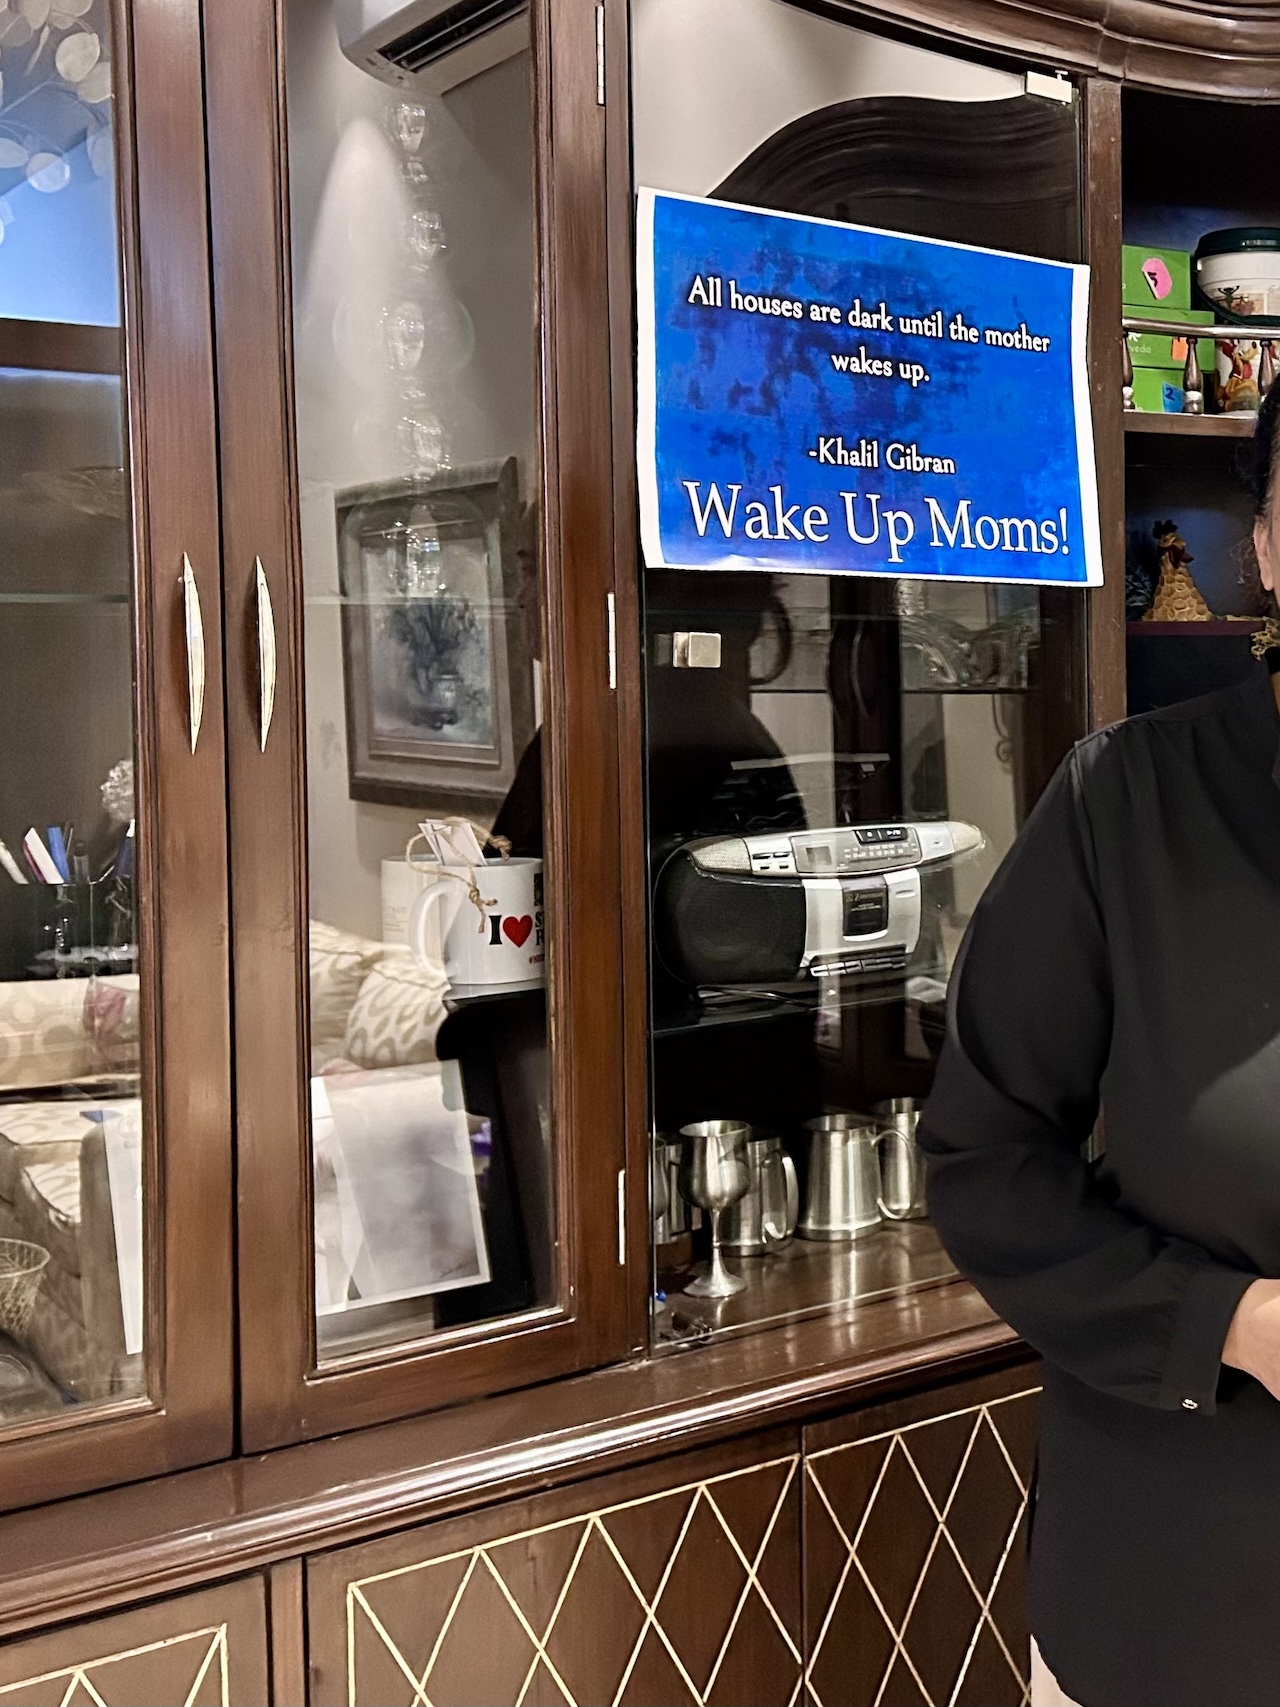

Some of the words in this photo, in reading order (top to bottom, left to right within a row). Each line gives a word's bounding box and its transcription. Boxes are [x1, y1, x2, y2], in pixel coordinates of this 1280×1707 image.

[688, 274, 722, 307] All
[730, 281, 803, 319] houses
[810, 303, 841, 324] are
[848, 299, 894, 332] dark
[899, 311, 943, 339] until
[949, 314, 979, 344] the
[985, 323, 1051, 353] mother
[831, 346, 893, 377] wakes
[899, 361, 930, 387] up.
[1164, 387, 1176, 401] 2
[809, 438, 878, 469] -Khalil
[885, 444, 956, 475] Gibran
[683, 480, 829, 542] Wake
[840, 491, 914, 562] Up
[924, 497, 1071, 555] Moms!
[489, 915, 502, 945] I
